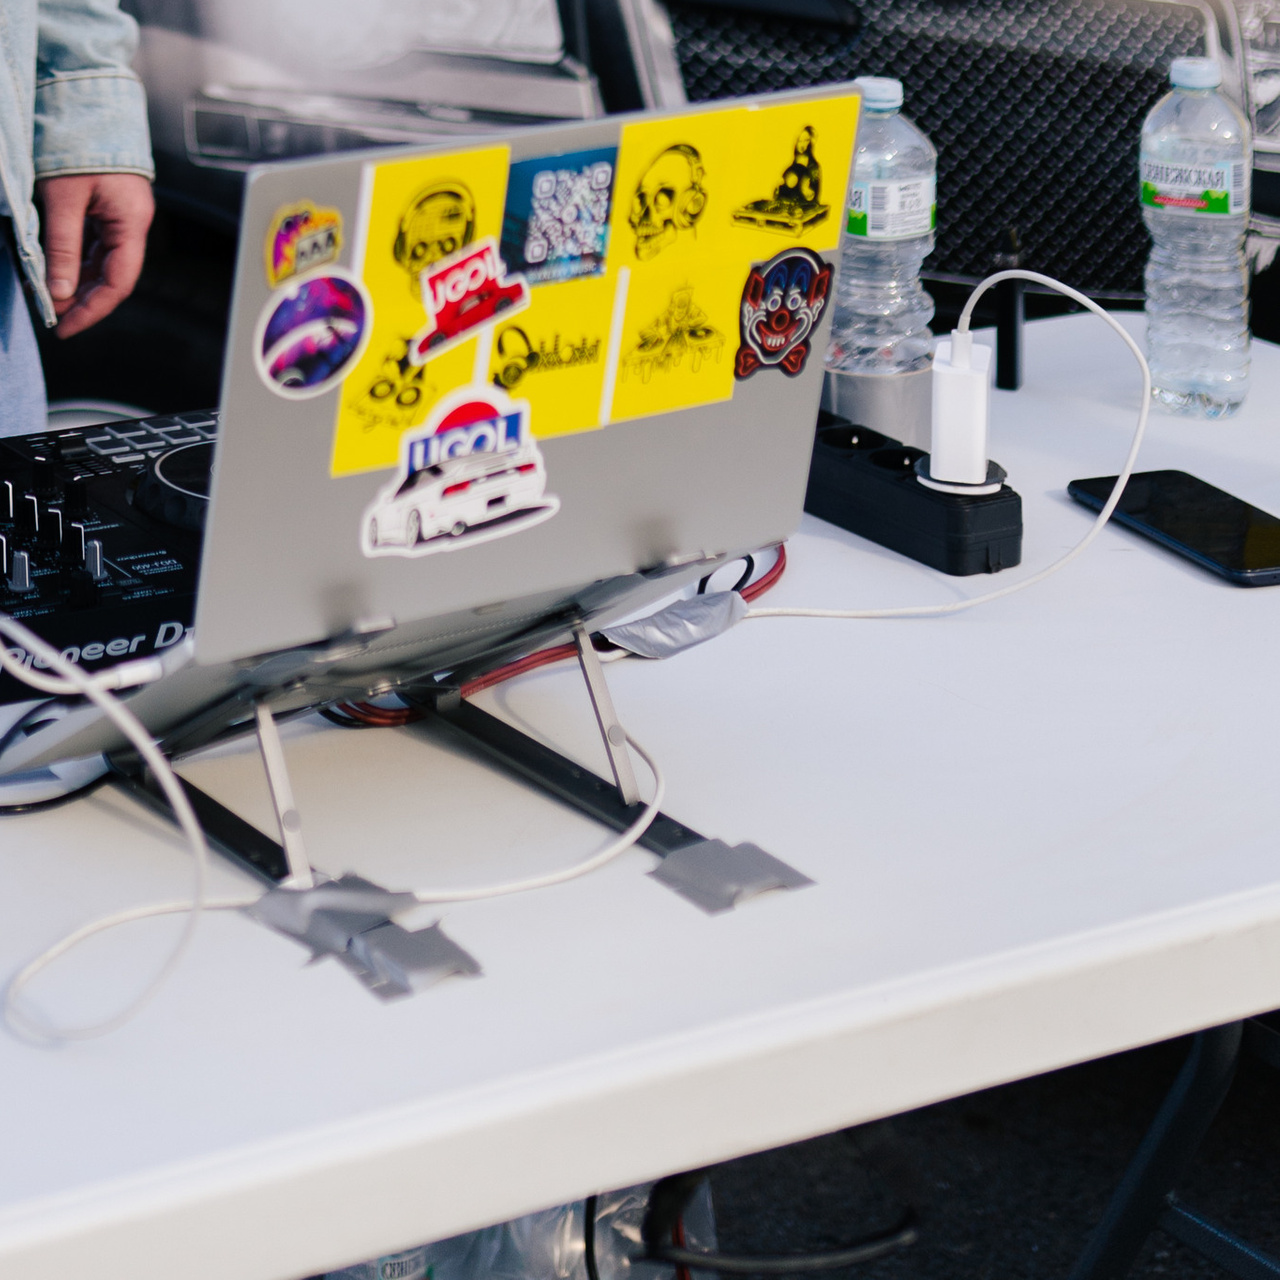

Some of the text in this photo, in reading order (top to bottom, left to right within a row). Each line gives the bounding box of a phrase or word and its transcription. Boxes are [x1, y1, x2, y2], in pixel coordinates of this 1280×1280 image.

[1143, 162, 1225, 188] ЕНЕЖСКАЯ
[424, 251, 505, 314] UGOL
[413, 419, 519, 472] UGOL
